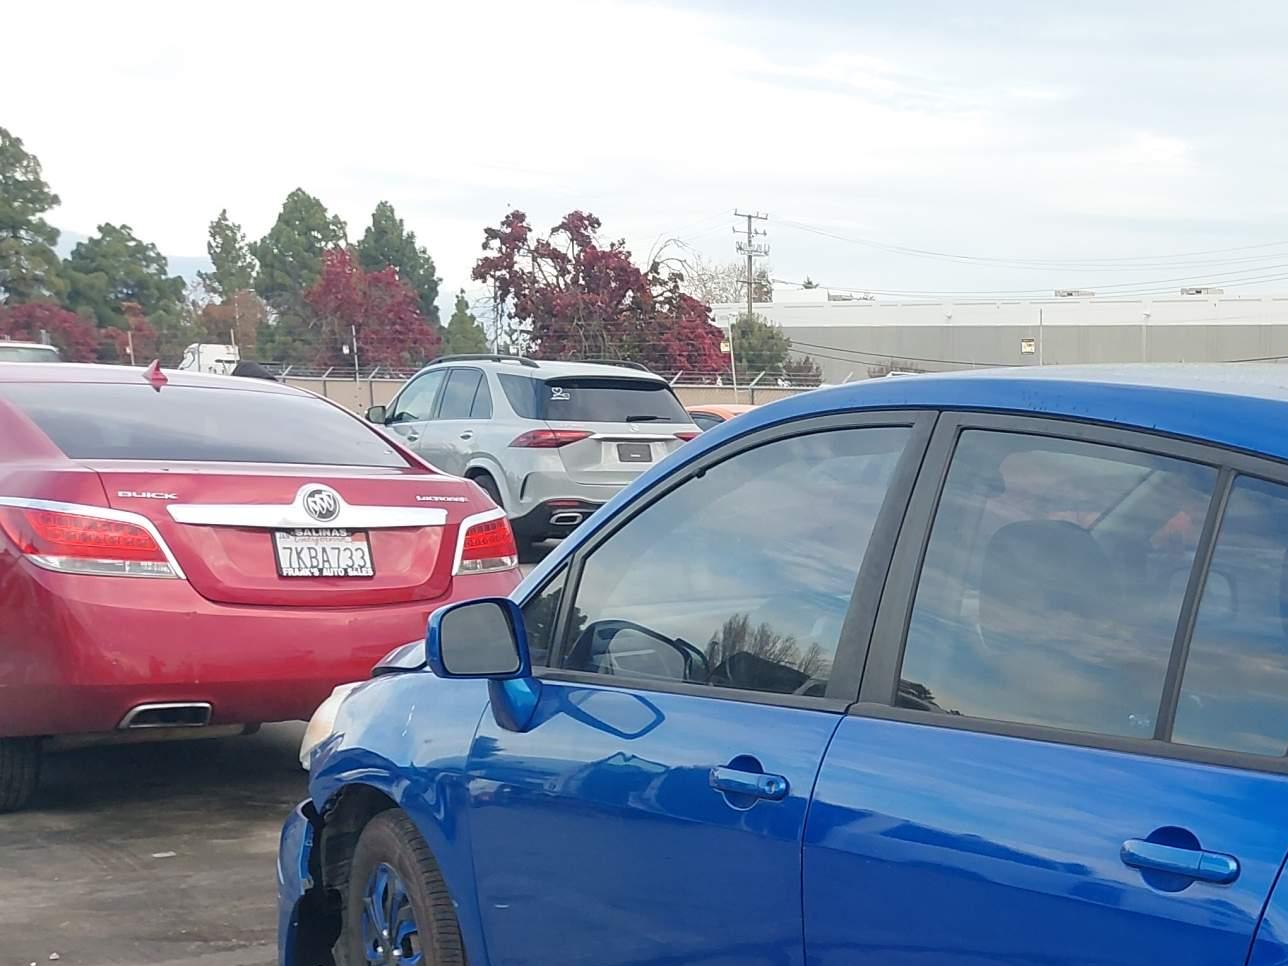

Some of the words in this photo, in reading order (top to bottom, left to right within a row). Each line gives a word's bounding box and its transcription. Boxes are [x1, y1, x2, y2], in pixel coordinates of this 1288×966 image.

[117, 491, 178, 499] BUICK
[295, 528, 347, 537] SALINAS
[282, 546, 367, 569] 7KBA733
[283, 567, 319, 577] FRANK'S
[322, 567, 345, 577] AUTO
[347, 567, 373, 577] SALES
